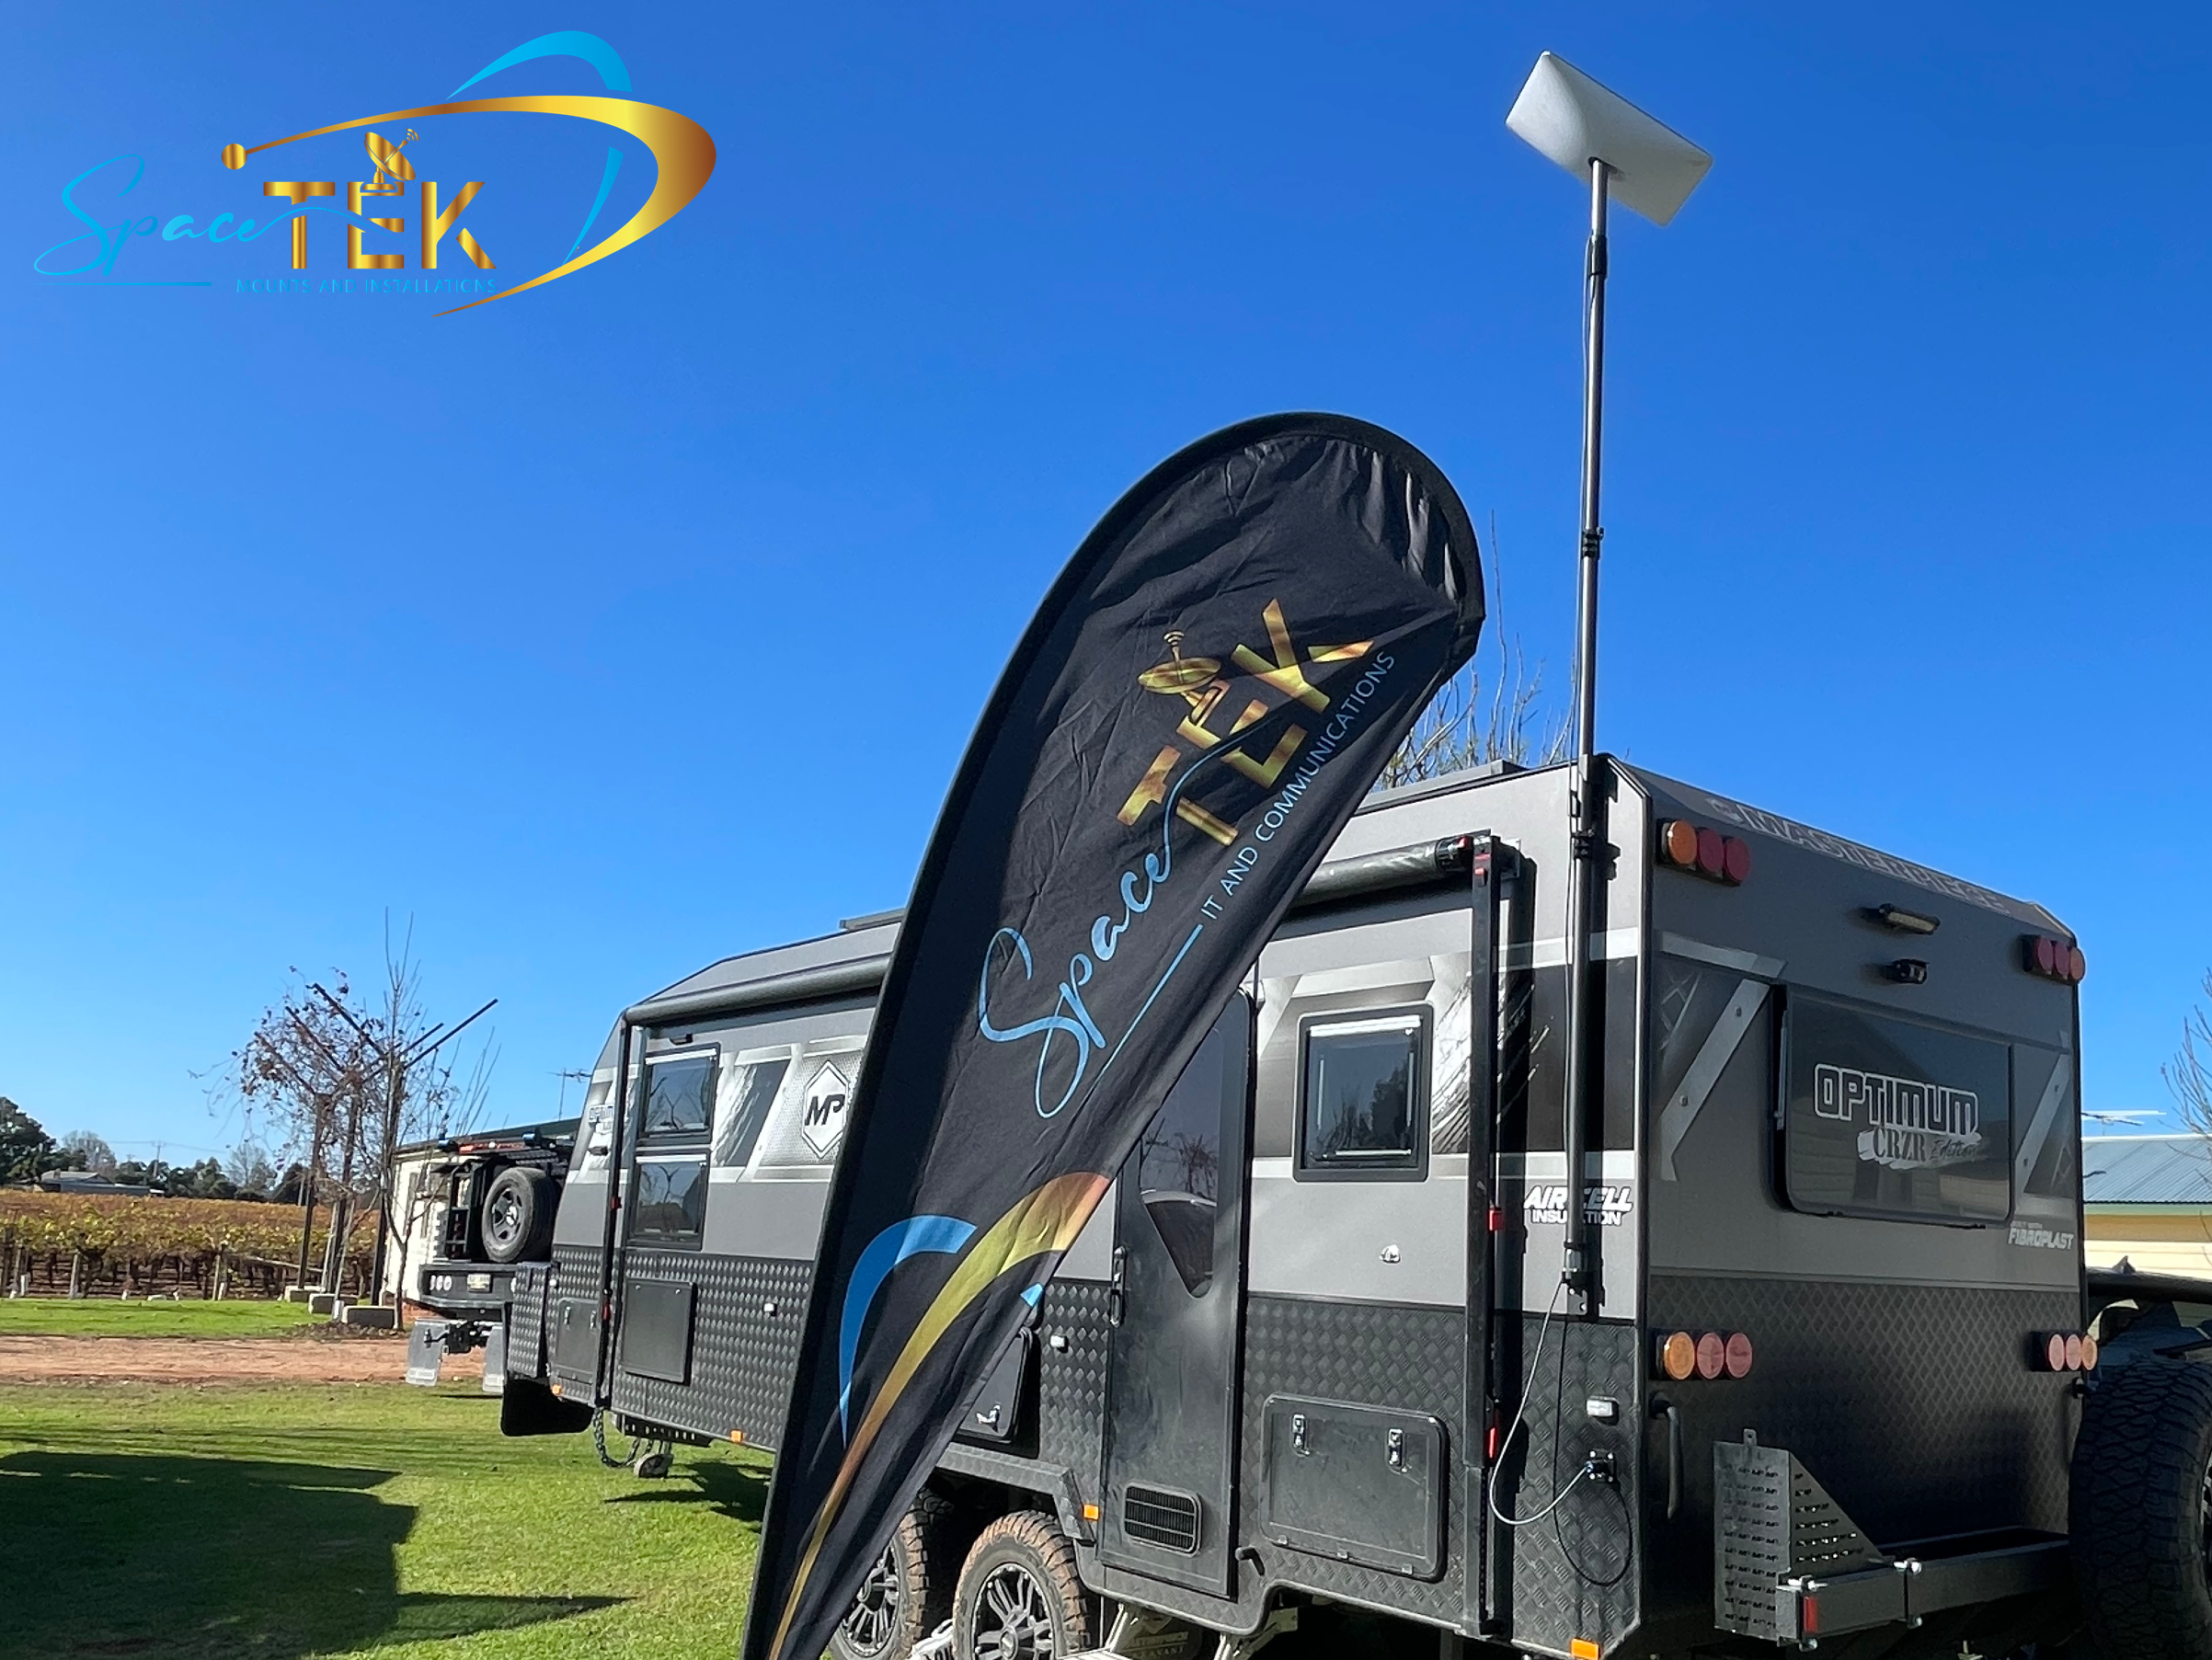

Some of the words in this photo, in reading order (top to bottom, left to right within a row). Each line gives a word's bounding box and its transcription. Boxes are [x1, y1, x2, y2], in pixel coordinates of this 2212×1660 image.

[1200, 895, 1224, 920] IT
[1220, 846, 1258, 897] AND
[1255, 651, 1395, 841] COMMUNICATIONS
[978, 851, 1172, 1118] Space
[1117, 598, 1374, 846] TEK
[805, 1093, 845, 1126] MP
[1815, 1063, 1979, 1137] OPTIMUM
[1873, 1127, 1927, 1162] CRZR
[1531, 1209, 1622, 1226] INSUTION
[2008, 1228, 2074, 1249] FIBROPLAST
